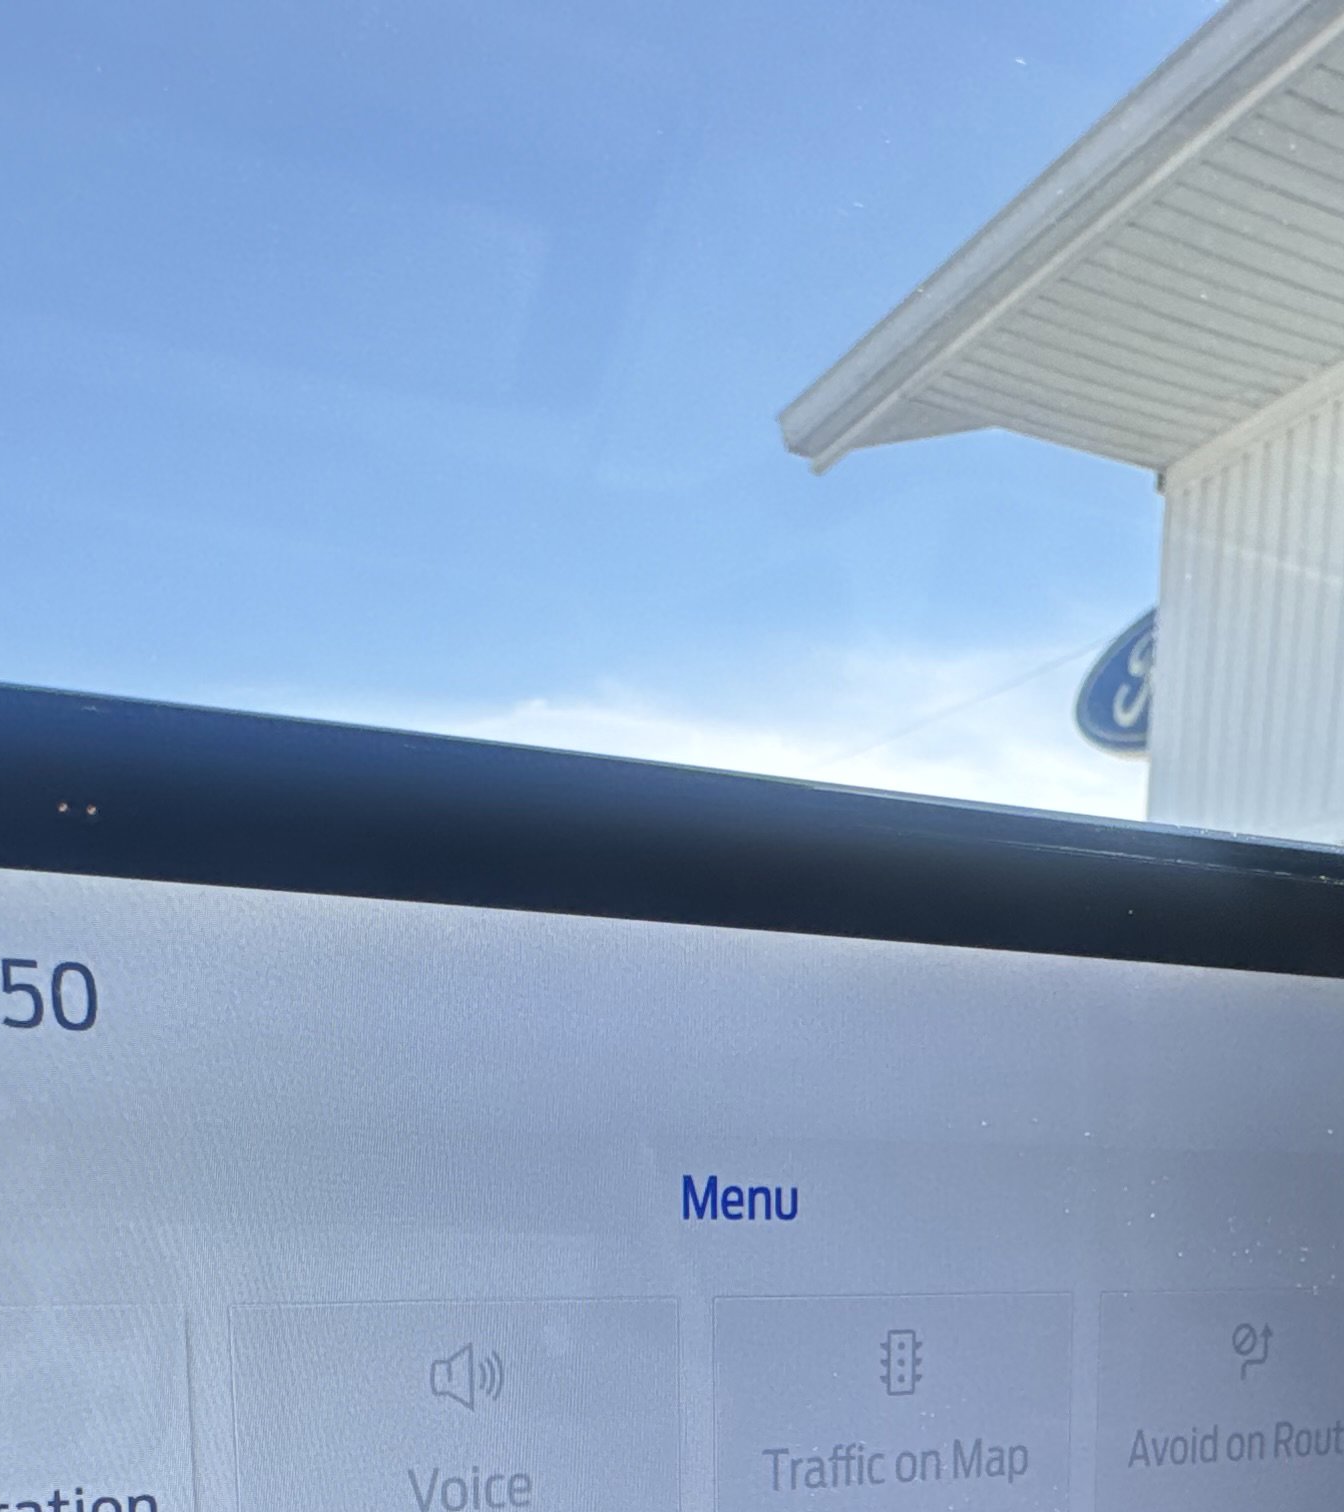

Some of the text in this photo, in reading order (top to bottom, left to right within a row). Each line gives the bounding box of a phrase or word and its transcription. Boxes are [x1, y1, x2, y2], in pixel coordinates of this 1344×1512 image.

[681, 1174, 800, 1222] Menu
[762, 1439, 1030, 1493] Traffic on Map
[1127, 1424, 1219, 1469] Avoid
[1226, 1430, 1267, 1463] on
